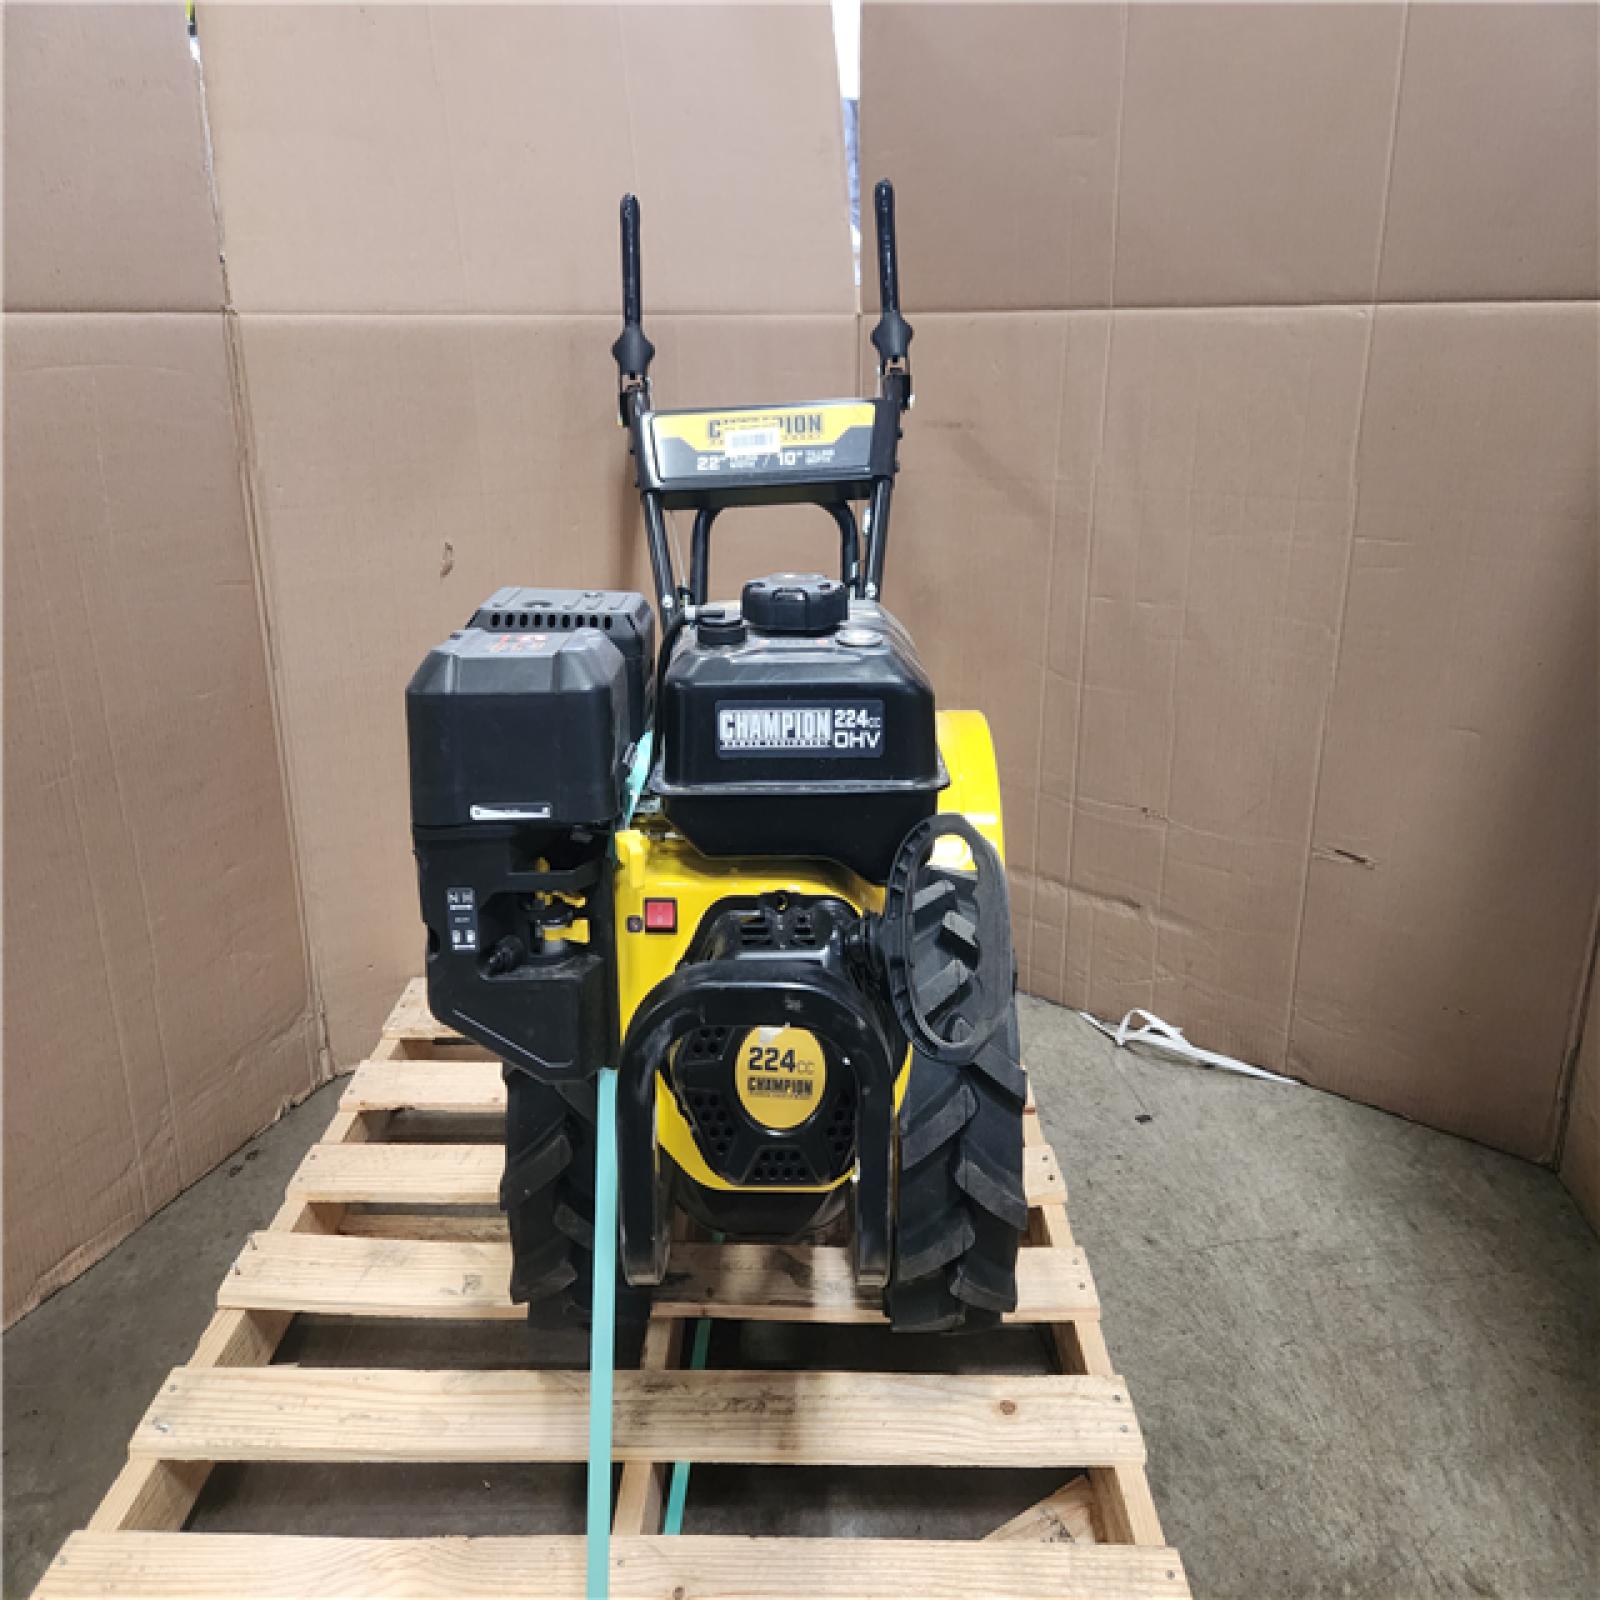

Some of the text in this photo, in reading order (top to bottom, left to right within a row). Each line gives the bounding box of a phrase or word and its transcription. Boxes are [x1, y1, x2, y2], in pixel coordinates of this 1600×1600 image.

[709, 414, 822, 438] CION
[719, 709, 831, 740] CHAMPION
[834, 731, 881, 749] OHV
[747, 1077, 814, 1096] CHAMPION
